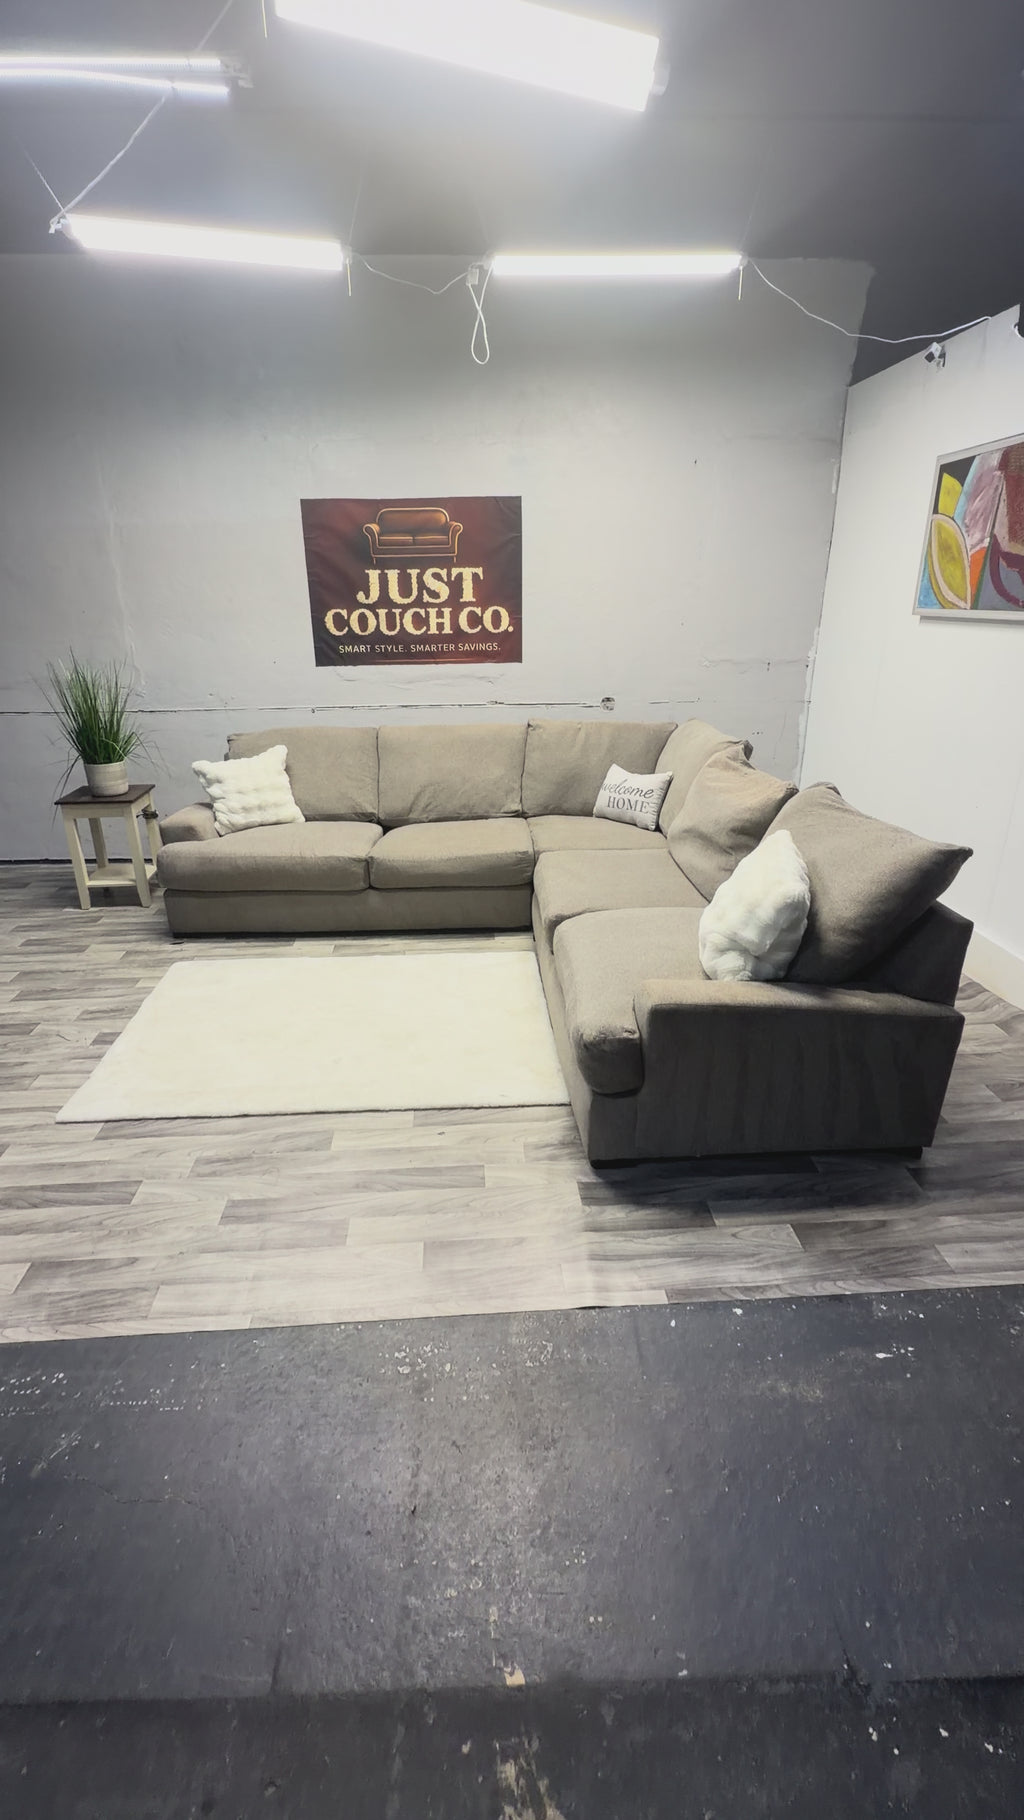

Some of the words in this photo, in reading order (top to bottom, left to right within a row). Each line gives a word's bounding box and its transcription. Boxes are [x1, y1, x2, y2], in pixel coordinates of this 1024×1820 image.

[356, 567, 484, 605] JUST
[324, 607, 453, 636] COUCH
[458, 606, 514, 633] CO.
[338, 644, 371, 654] SMART
[375, 644, 407, 653] STYLE.
[410, 643, 455, 653] SMARTER
[458, 642, 501, 652] SAVINGS.
[601, 779, 655, 798] welcome
[607, 796, 650, 814] HOME
